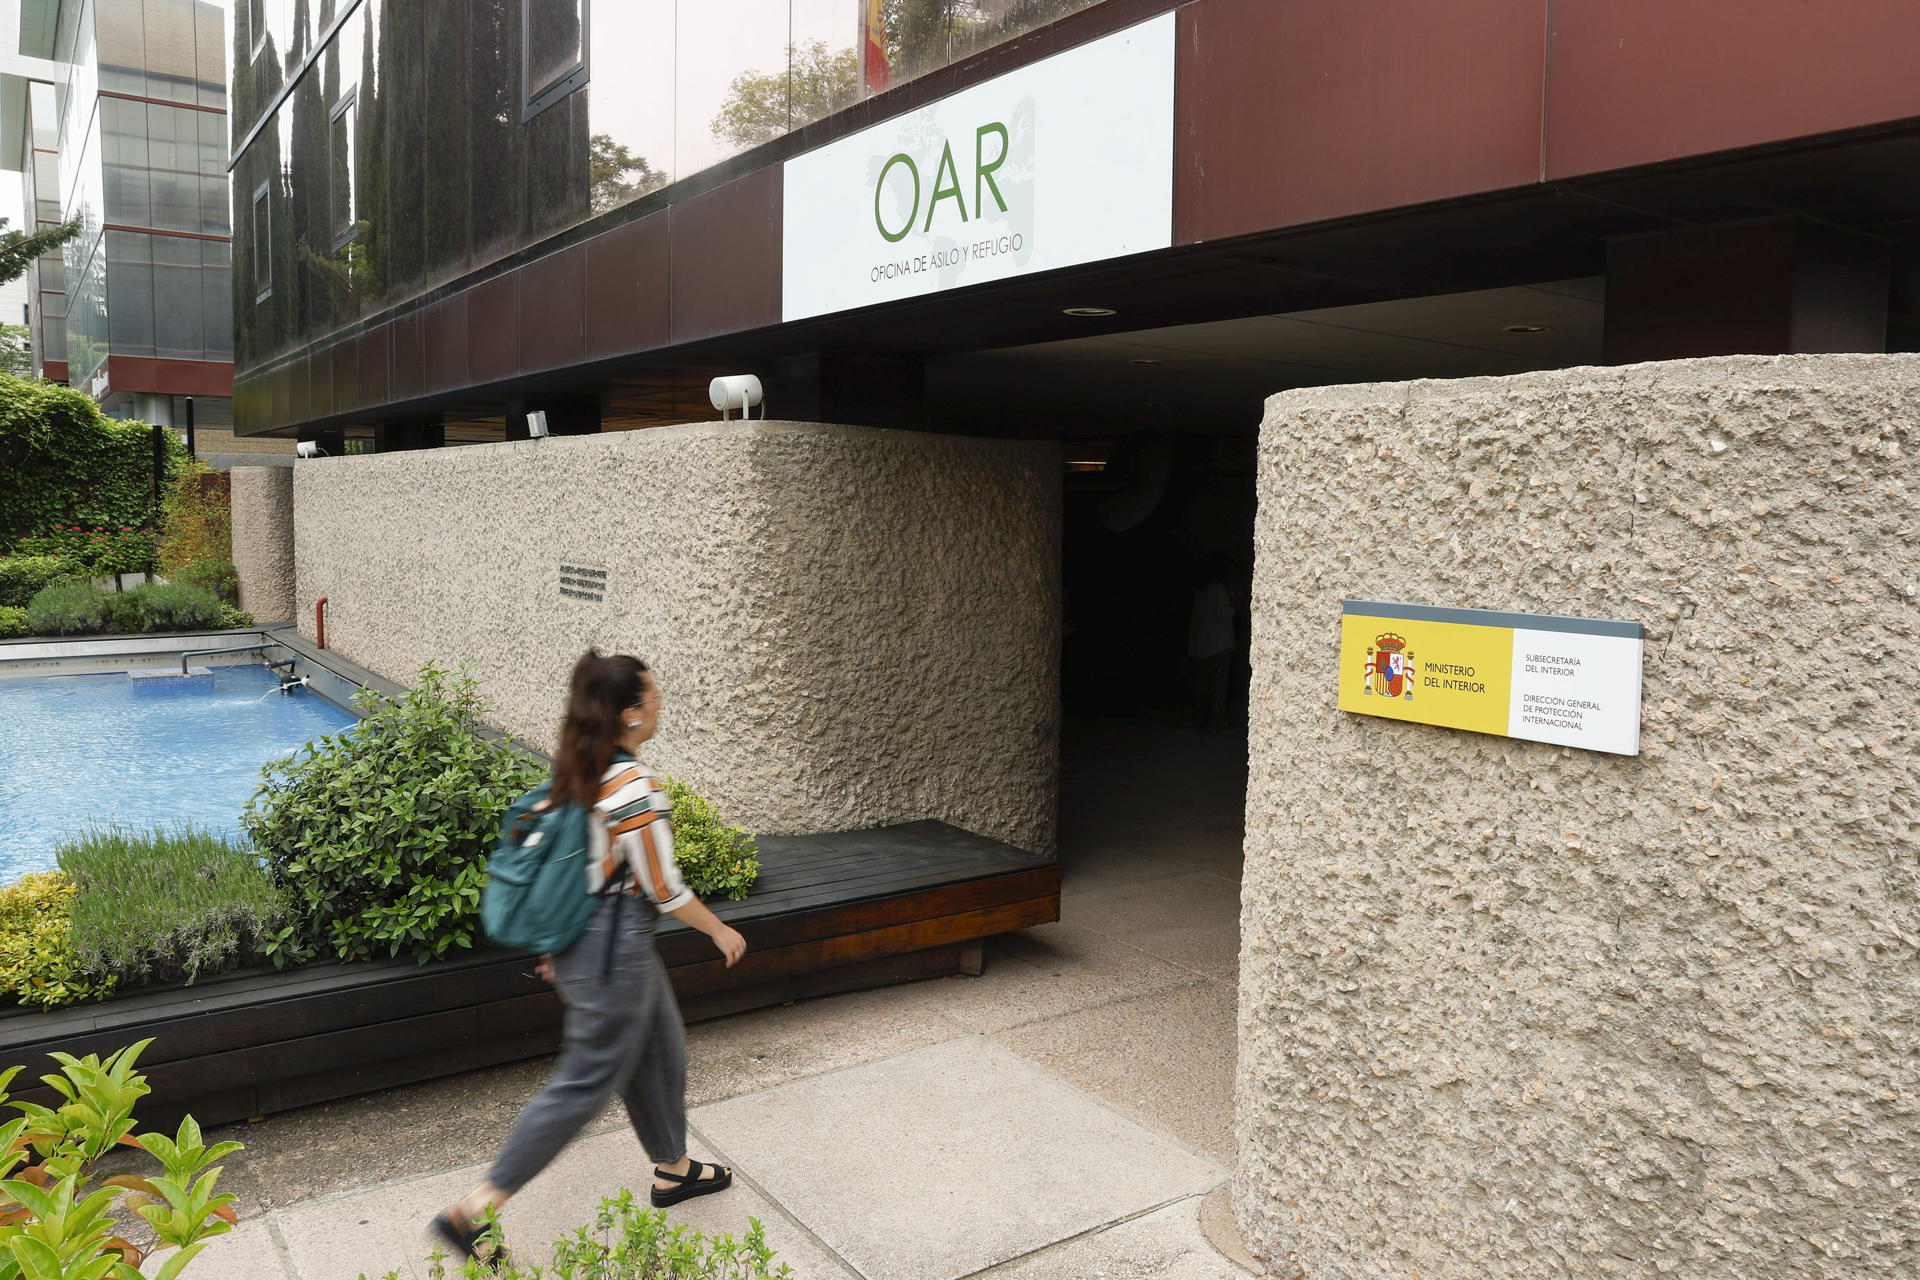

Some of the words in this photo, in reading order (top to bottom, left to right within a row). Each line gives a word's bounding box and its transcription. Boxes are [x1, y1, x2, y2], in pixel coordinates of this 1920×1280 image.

[875, 122, 1008, 243] OAR
[871, 261, 910, 282] OFICINA
[913, 255, 927, 272] DE
[929, 248, 959, 270] ASILO
[962, 246, 969, 262] Y
[972, 233, 1023, 260] REFUGIO
[1525, 653, 1581, 667] SUBSECRETARÍA
[1424, 662, 1475, 677] MINISTERIO
[1525, 664, 1538, 673] DEL
[1540, 666, 1575, 676] INTERIOR
[1424, 676, 1440, 688] DEL
[1443, 679, 1486, 693] INTERIOR
[1523, 694, 1565, 706] DIRECCIÓN
[1566, 699, 1601, 711] GENERAL
[1523, 704, 1533, 713] DE
[1534, 705, 1583, 719] PROTECCIÓN
[1522, 715, 1583, 731] INTERNACIONAL
